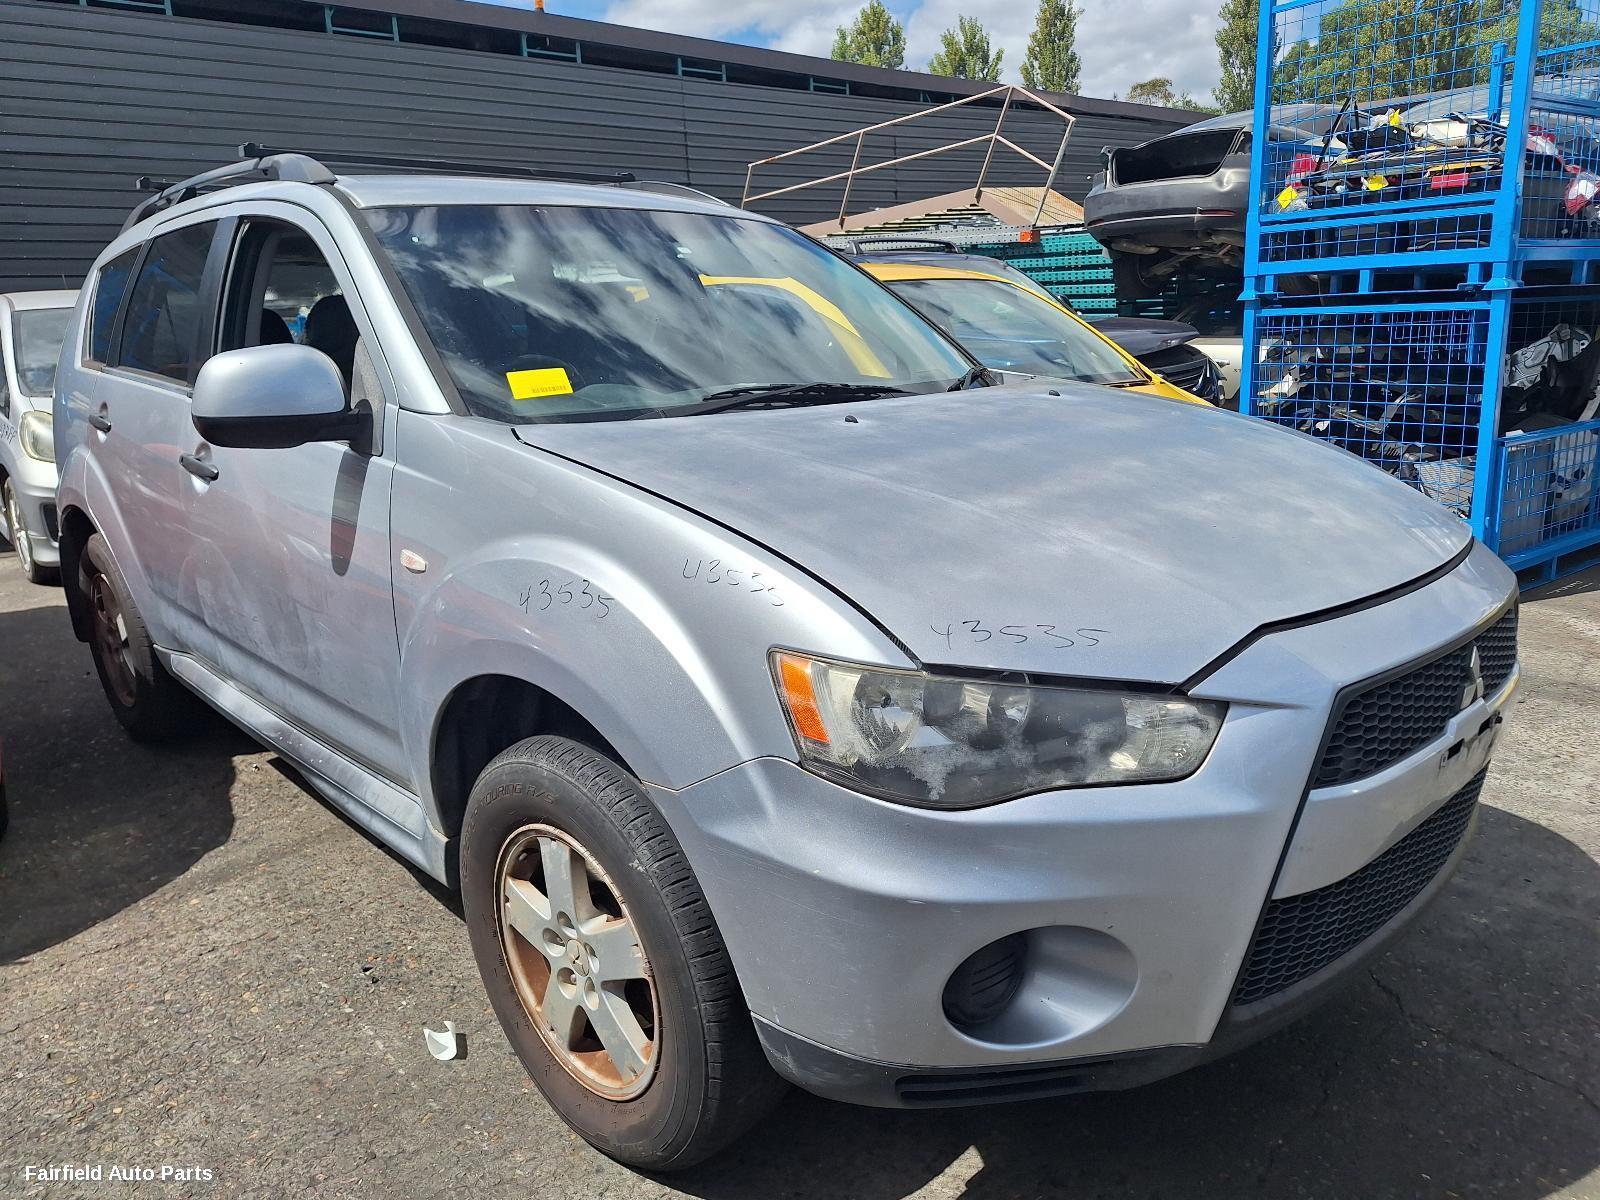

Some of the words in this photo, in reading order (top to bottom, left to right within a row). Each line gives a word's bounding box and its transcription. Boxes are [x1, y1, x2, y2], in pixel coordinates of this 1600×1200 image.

[519, 578, 615, 619] 43535
[682, 557, 785, 607] 43535
[930, 620, 1112, 650] 43535
